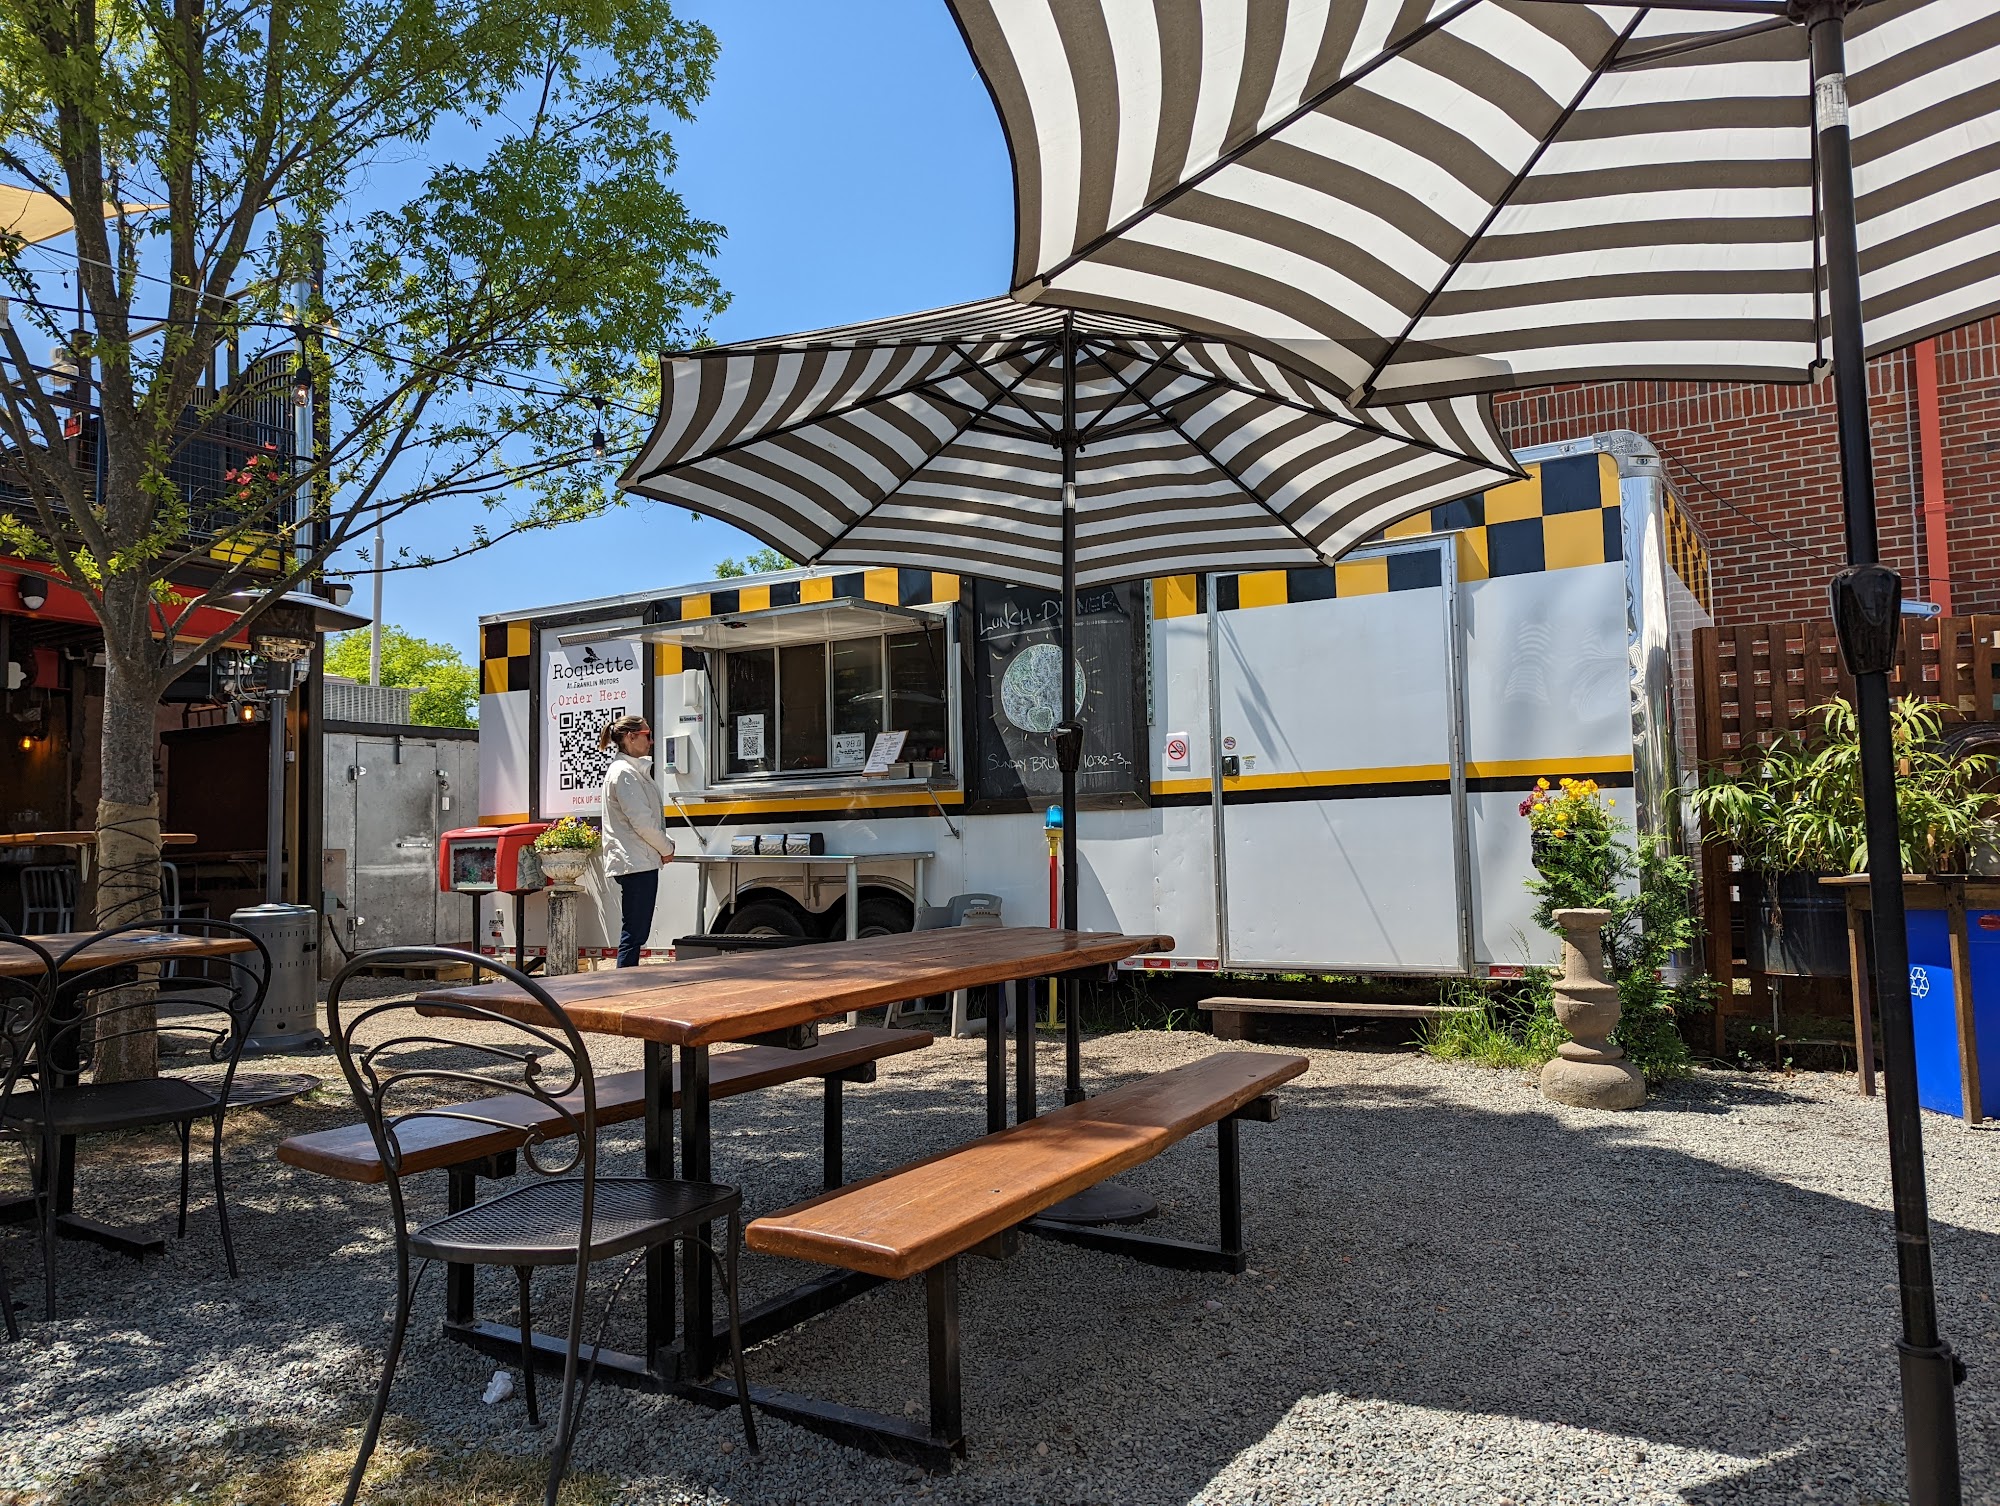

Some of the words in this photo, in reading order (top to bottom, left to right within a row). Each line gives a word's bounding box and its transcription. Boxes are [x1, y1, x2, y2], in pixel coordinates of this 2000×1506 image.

[553, 656, 634, 680] Roquette
[574, 680, 598, 689] FRANKLIN
[599, 677, 620, 686] MOTORS
[558, 693, 593, 706] Order
[599, 689, 627, 702] Here
[987, 753, 1027, 772] SUNDAY
[1029, 756, 1059, 772] BRUN
[572, 796, 585, 804] PICK
[585, 795, 593, 804] UP
